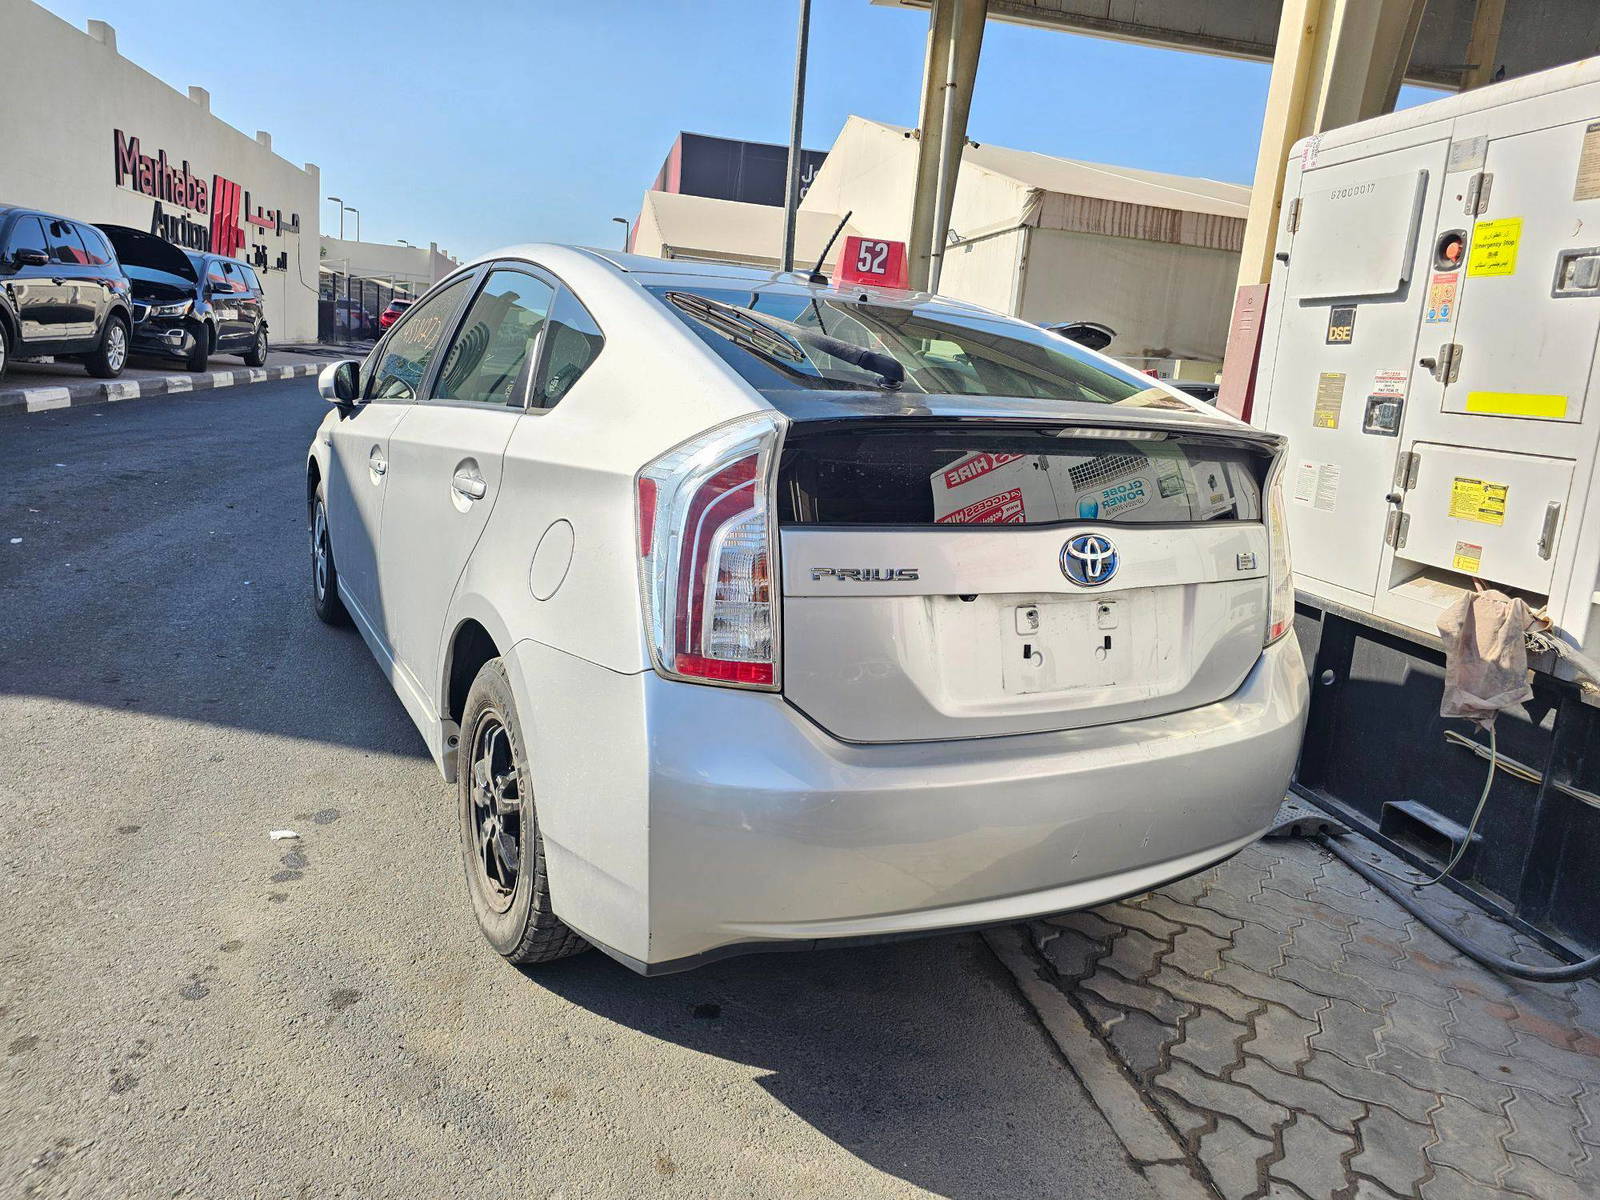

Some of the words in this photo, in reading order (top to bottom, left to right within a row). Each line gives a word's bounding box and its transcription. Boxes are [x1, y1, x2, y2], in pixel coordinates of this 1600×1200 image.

[113, 128, 208, 215] Marhaba
[150, 200, 209, 252] Auction
[245, 191, 300, 237] مرحبا
[857, 240, 889, 274] 52
[1329, 326, 1351, 340] DSE
[810, 567, 919, 581] PRIUS
